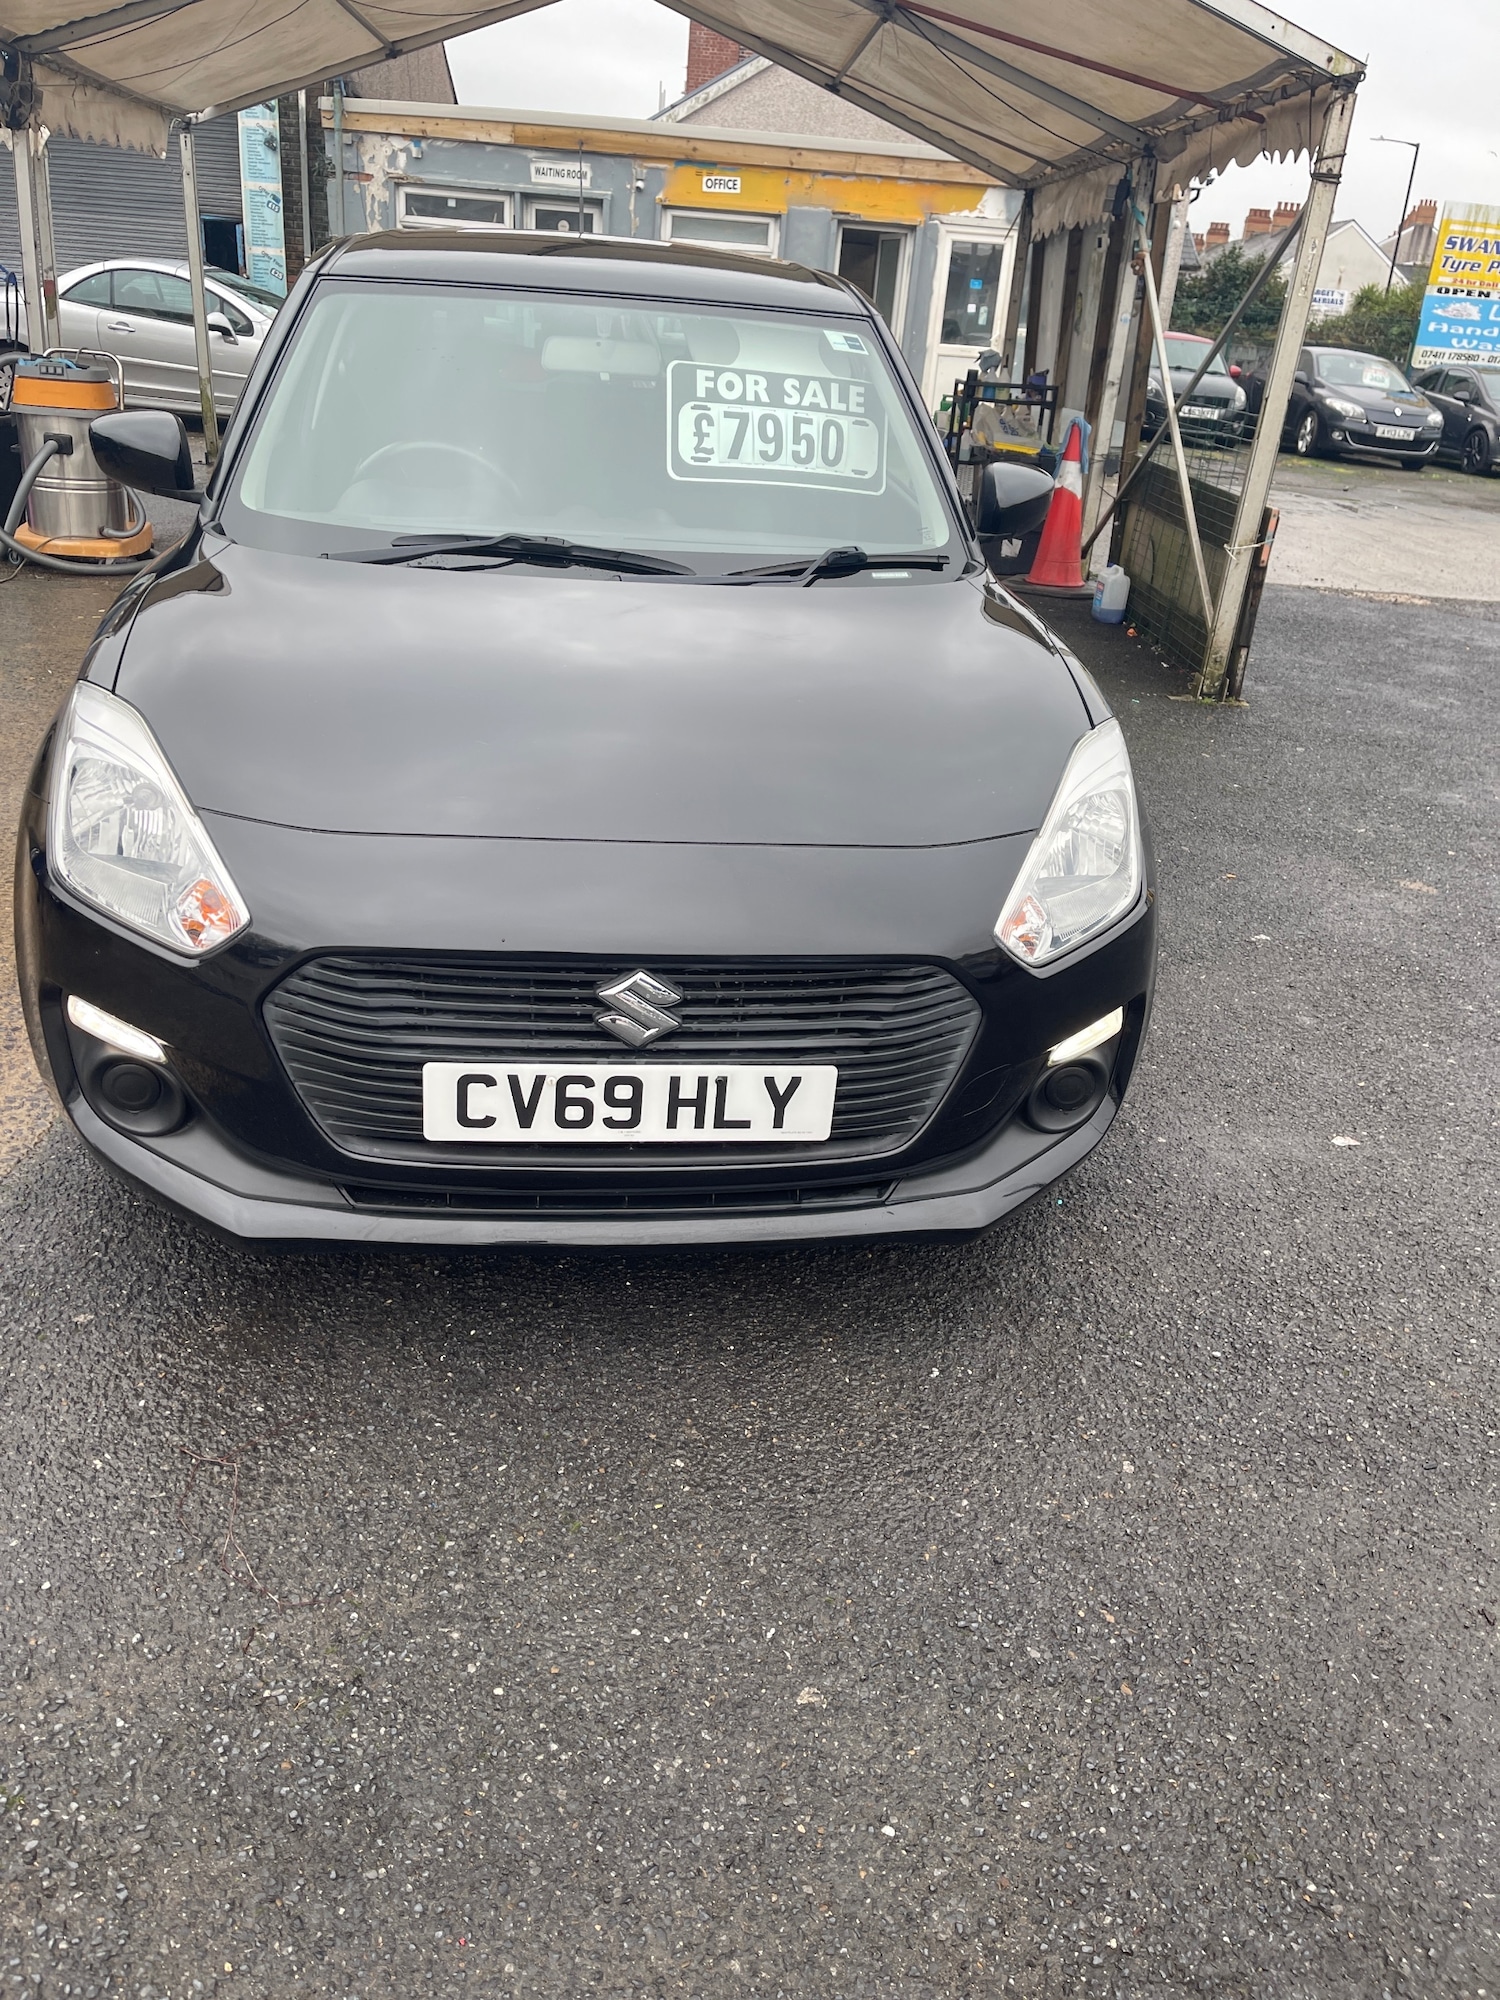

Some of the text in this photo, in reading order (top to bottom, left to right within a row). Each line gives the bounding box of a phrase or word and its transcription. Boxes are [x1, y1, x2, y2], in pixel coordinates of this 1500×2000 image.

[534, 166, 588, 180] WAITING ROOM
[705, 178, 738, 190] OFFICE
[1442, 255, 1482, 273] Tyre
[1437, 286, 1491, 298] OPEN
[1312, 297, 1344, 306] AERIALS
[1428, 321, 1499, 337] Hand
[1421, 349, 1446, 359] 07411
[696, 368, 866, 415] FOR SALE
[693, 410, 845, 468] £7950
[456, 1073, 803, 1130] CV69 HLY
